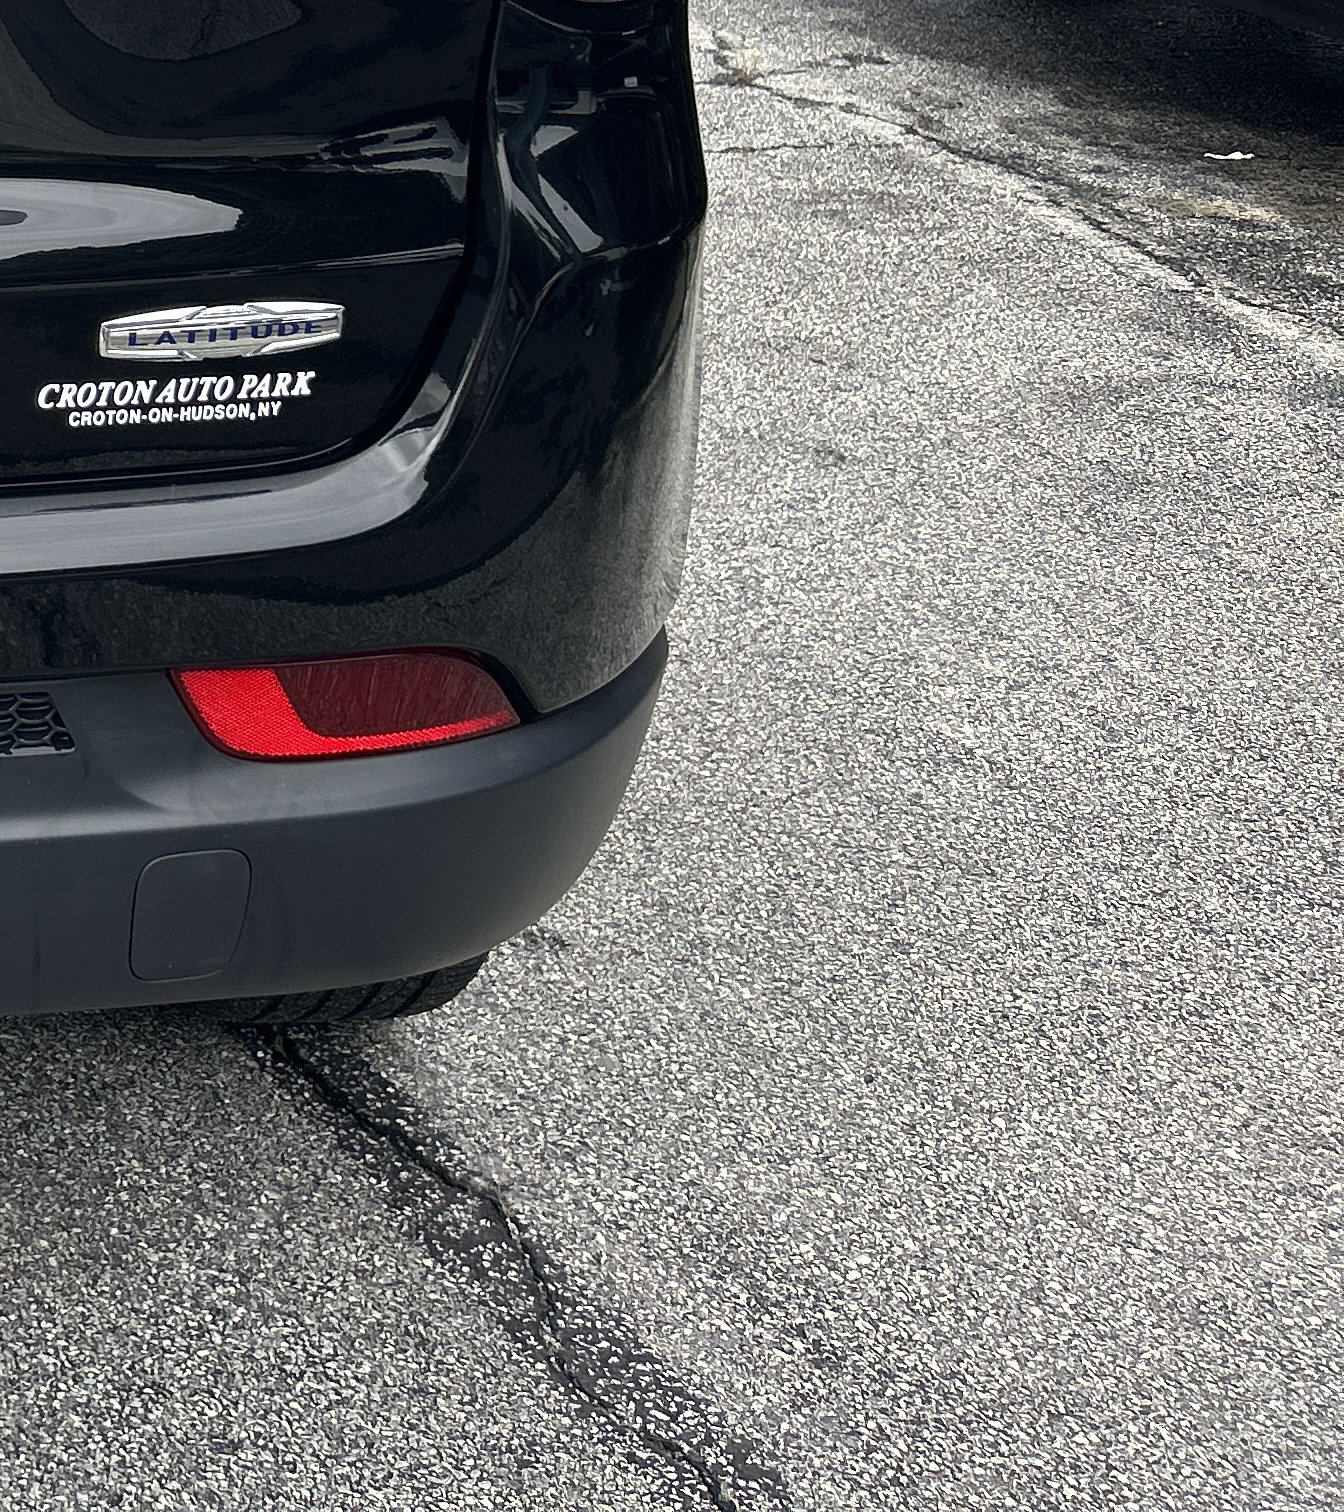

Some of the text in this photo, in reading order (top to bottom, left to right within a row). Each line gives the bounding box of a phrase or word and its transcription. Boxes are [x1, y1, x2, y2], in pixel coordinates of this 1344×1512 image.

[127, 321, 323, 347] LATITUDE
[36, 370, 316, 411] CROTON AUTO PARK
